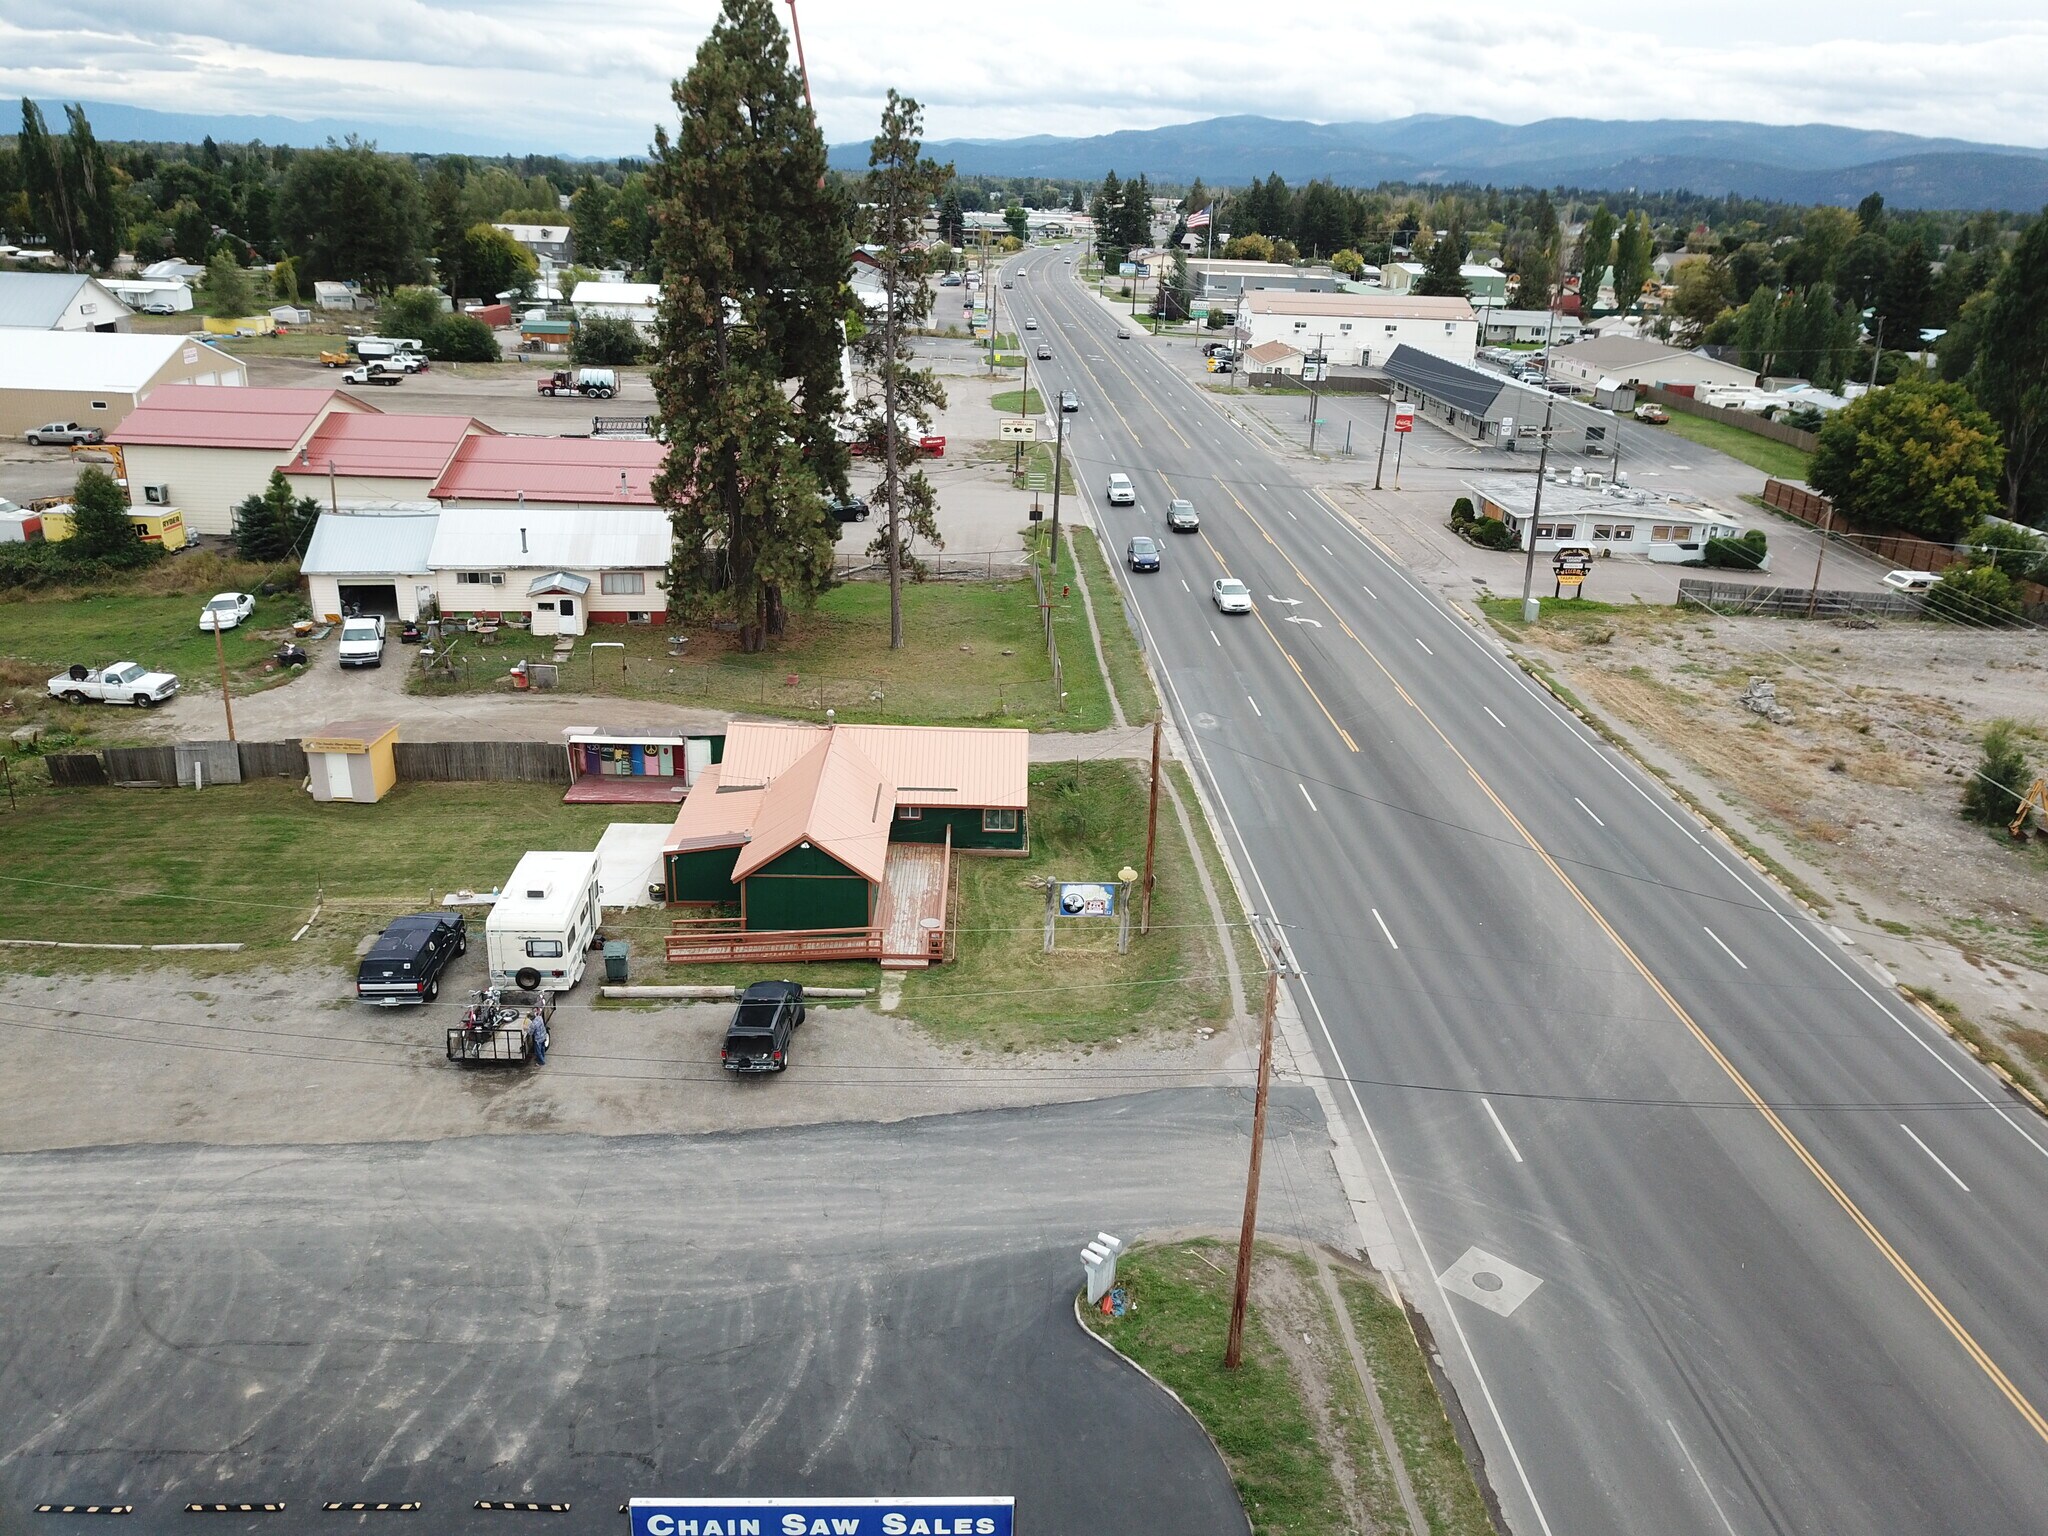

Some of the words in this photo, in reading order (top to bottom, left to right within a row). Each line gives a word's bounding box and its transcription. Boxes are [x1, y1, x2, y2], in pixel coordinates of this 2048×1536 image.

[162, 516, 180, 527] RYDER
[647, 1514, 760, 1536] CHAIN
[781, 1514, 860, 1536] SAW
[882, 1513, 995, 1535] SALES
